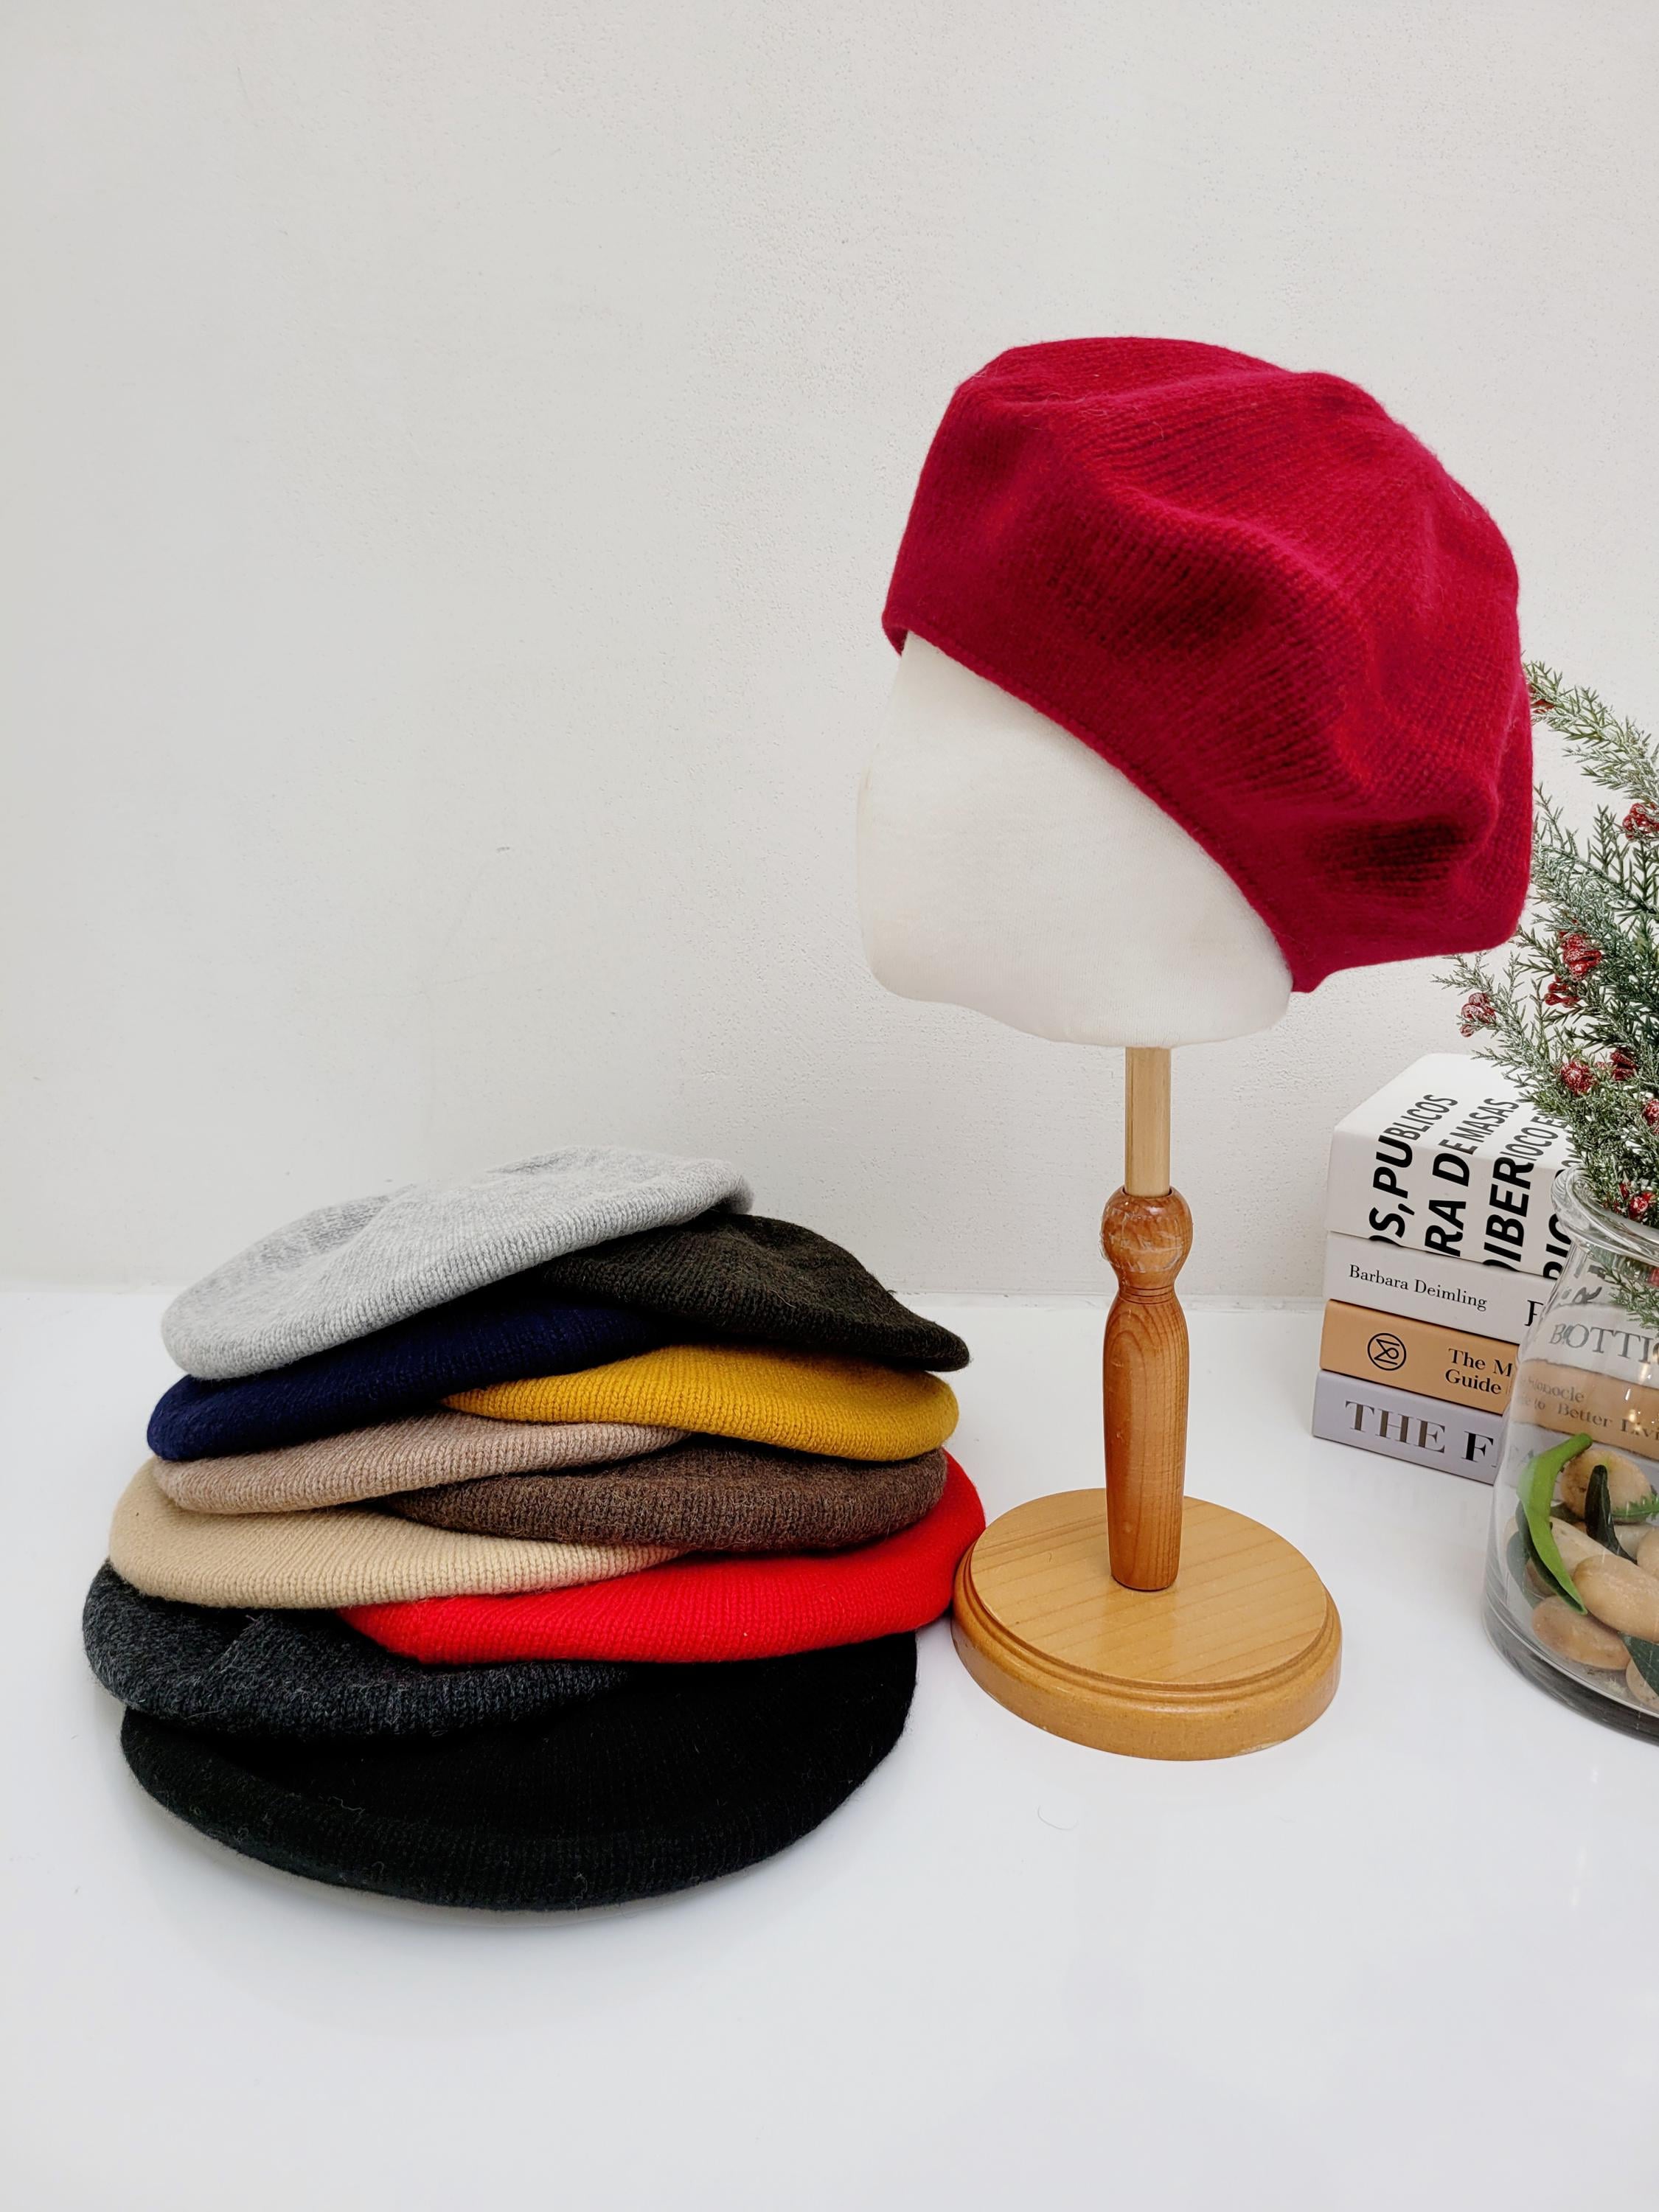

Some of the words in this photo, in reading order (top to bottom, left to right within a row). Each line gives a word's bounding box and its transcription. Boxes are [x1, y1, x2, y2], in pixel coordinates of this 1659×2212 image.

[1449, 1098, 1520, 1143] MASAS
[1483, 1127, 1559, 1272] IBERIOCO
[1349, 1264, 1409, 1290] Barbara
[1414, 1279, 1487, 1312] Deimling
[1445, 1368, 1501, 1395] Guide
[1448, 1348, 1486, 1370] The
[1345, 1400, 1446, 1453] THE
[1461, 1430, 1498, 1467] F
[1557, 1402, 1613, 1428] Better
